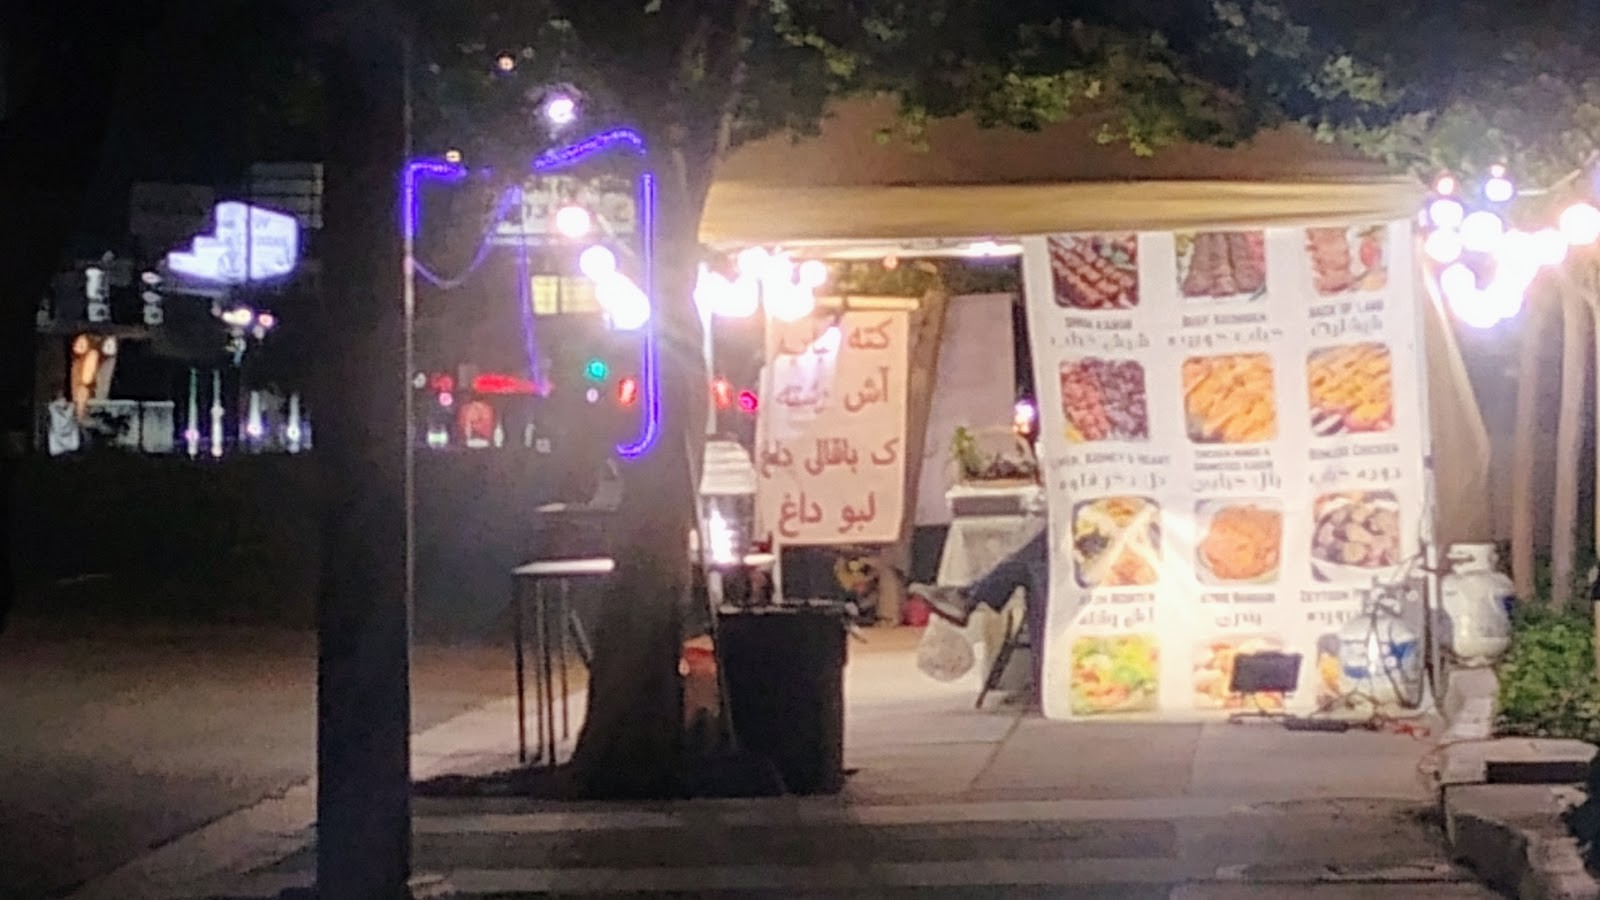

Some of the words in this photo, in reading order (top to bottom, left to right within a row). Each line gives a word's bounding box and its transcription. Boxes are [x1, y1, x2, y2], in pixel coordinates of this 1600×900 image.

[843, 366, 891, 414] آش
[778, 490, 824, 538] داغ
[836, 489, 877, 536] لبو
